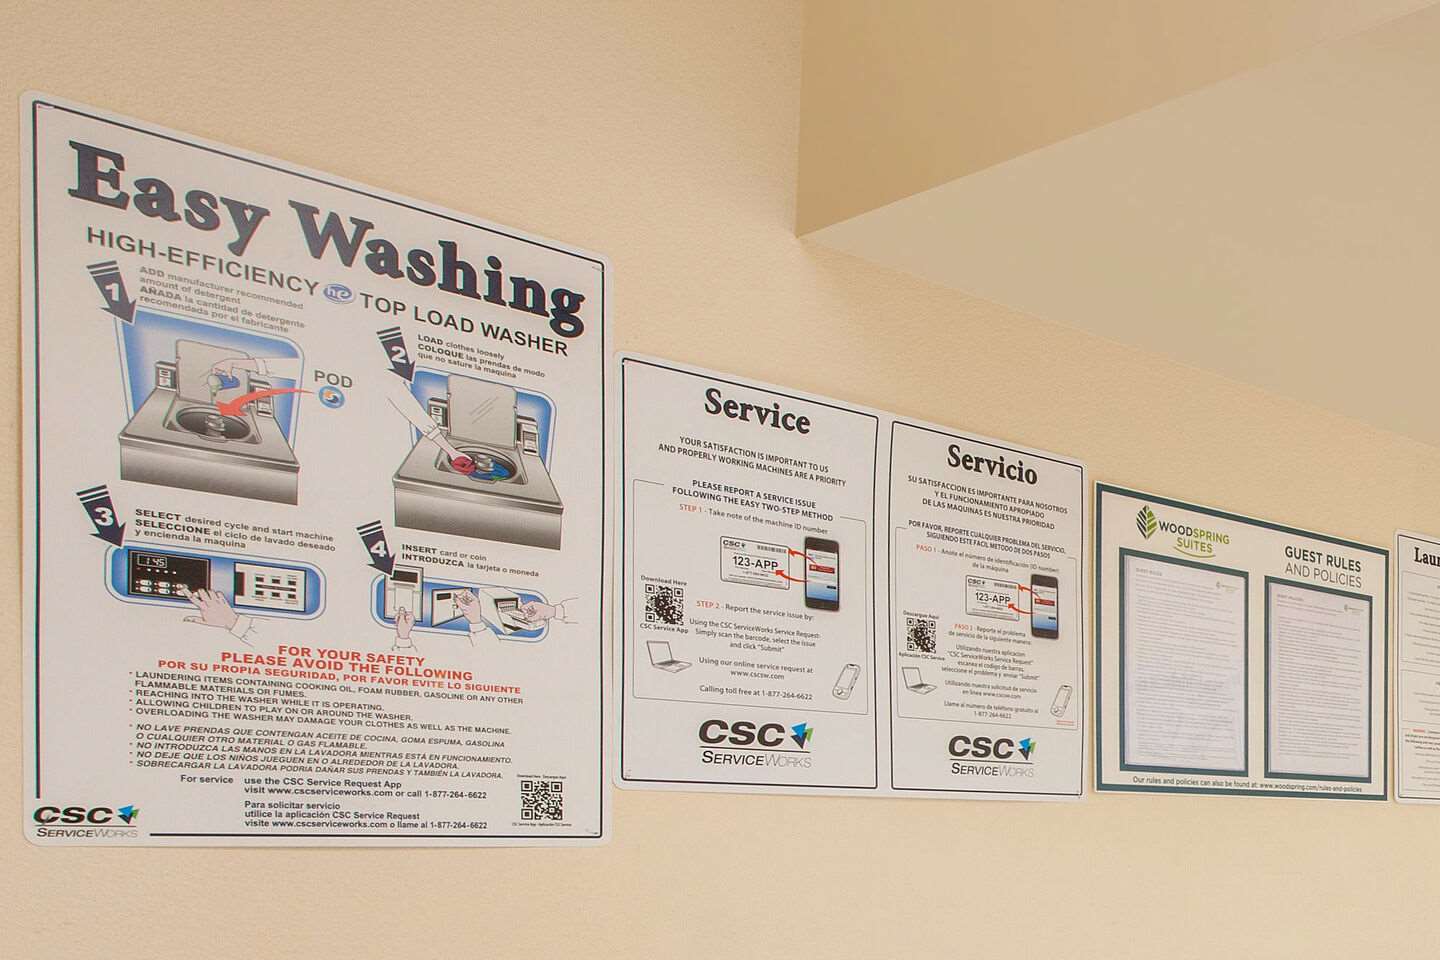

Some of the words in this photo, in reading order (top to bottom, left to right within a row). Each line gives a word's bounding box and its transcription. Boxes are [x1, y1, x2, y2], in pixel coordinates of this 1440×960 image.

[66, 138, 270, 256] Easy
[288, 199, 586, 340] Washing
[86, 226, 320, 297] HIGH-EFFICIENCY
[359, 292, 407, 316] TOP
[414, 305, 475, 333] LOAD
[480, 322, 568, 357] WASHER
[105, 282, 120, 301] 1
[391, 346, 406, 364] 2
[314, 370, 353, 389] POD
[705, 387, 811, 434] Service
[658, 443, 676, 454] AND
[677, 446, 717, 462] PROPERLY
[718, 455, 755, 469] WORKING
[755, 462, 793, 477] MACHINES
[794, 470, 808, 480] ARE
[808, 473, 815, 481] A
[815, 474, 847, 487] PRIORITY
[679, 435, 702, 448] YOUR
[702, 440, 757, 459] SATISFACTION
[757, 451, 765, 461] IS
[765, 453, 808, 469] IMPORTANT
[808, 462, 819, 471] TO
[819, 464, 829, 474] US
[947, 444, 1038, 485] Servicio
[692, 479, 723, 492] PLEASE
[723, 485, 755, 498] REPORT
[755, 491, 762, 499] A
[762, 492, 794, 505] SERVICE
[795, 498, 817, 509] ISSUE
[94, 506, 113, 526] 3
[135, 508, 182, 522] SELECT
[184, 516, 222, 527] desired
[223, 522, 250, 531] cycle
[251, 525, 270, 534] and
[271, 528, 294, 537] start
[295, 531, 334, 542] machine
[723, 539, 741, 548] CSC
[1159, 520, 1230, 545] WOODSPRING
[370, 540, 387, 558] 4
[401, 543, 438, 555] INSERT
[439, 550, 458, 558] card
[469, 554, 487, 562] coin
[1176, 536, 1213, 554] SUITES
[401, 552, 465, 568] INTRODUZCA
[467, 561, 475, 569] la
[476, 563, 501, 572] tarjeta
[509, 568, 539, 577] moneda
[732, 555, 779, 571] 123-APP
[1285, 545, 1323, 565] GUEST
[1326, 554, 1362, 573] RULES
[1285, 562, 1310, 579] AND
[1313, 567, 1362, 589] POLICIES
[975, 592, 1011, 604] 123-APP
[221, 651, 288, 667] PLEASE
[292, 657, 344, 671] AVOID
[348, 661, 381, 674] THE
[385, 665, 473, 681] FOLLOWING
[278, 645, 312, 658] FOR
[316, 648, 362, 662] YOUR
[366, 652, 425, 667] SAFETY
[158, 659, 186, 670] POR
[190, 662, 209, 672] SU
[212, 663, 261, 676] PROPIA
[343, 673, 367, 683] POR
[370, 675, 409, 686] FAVOR
[412, 679, 444, 689] EVITE
[447, 681, 462, 690] LO
[464, 683, 521, 695] SIGUIENTE
[699, 684, 724, 695] Calling
[738, 687, 752, 696] free
[753, 689, 761, 697] at
[698, 719, 785, 747] CSC
[948, 735, 1015, 759] CSC
[180, 774, 197, 783] For
[199, 776, 234, 784] service
[264, 776, 281, 785] the
[282, 777, 304, 786] CSC
[306, 778, 342, 787] Service
[344, 779, 382, 788] Request
[383, 780, 402, 790] App
[1133, 775, 1145, 784] Our
[1146, 776, 1162, 785] rules
[1163, 777, 1175, 786] and
[1176, 777, 1199, 788] policies
[1200, 779, 1211, 787] can
[1212, 779, 1224, 788] also
[1225, 780, 1233, 788] be
[1234, 780, 1250, 789] found
[33, 806, 113, 824] CSC
